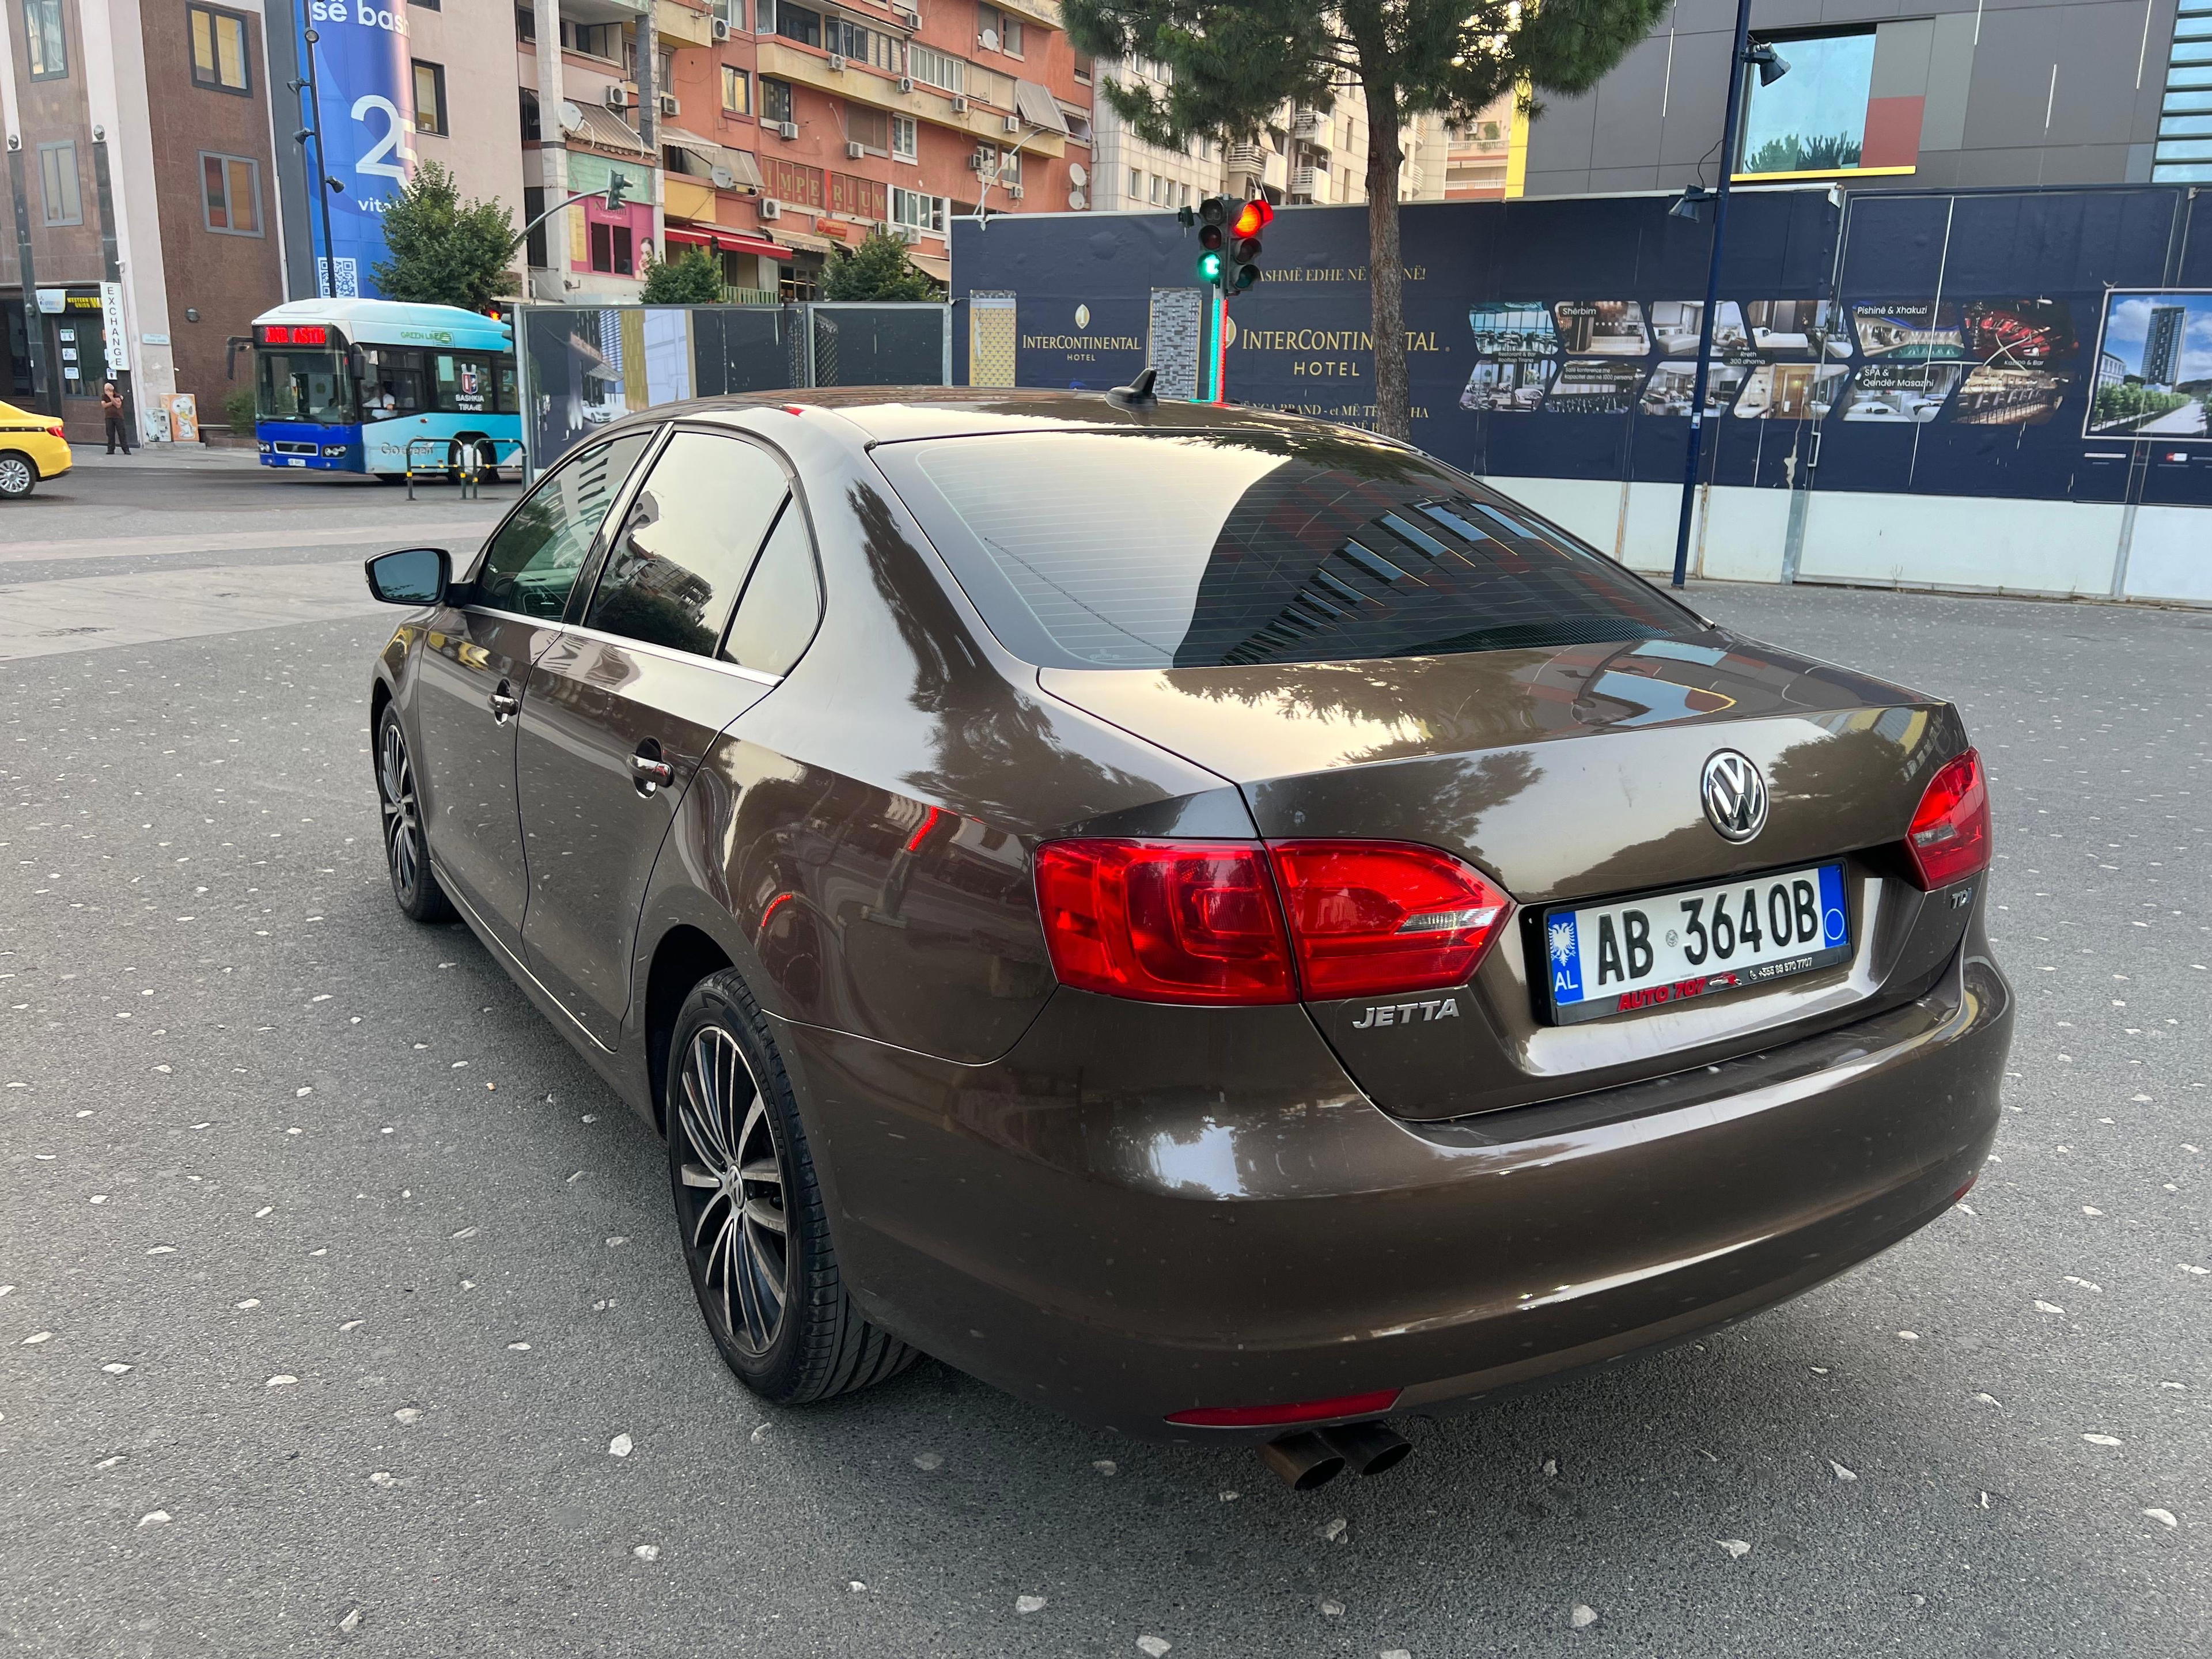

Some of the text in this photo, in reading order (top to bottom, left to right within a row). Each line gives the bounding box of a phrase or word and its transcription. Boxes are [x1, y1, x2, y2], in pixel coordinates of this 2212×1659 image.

[1306, 269, 1344, 281] EDHE
[1347, 266, 1366, 281] NË
[1857, 305, 1928, 315] Pishinë & Xhakuzi
[107, 287, 123, 366] EXCHANGE
[1023, 335, 1141, 350] INTERCONTINENTAL
[1243, 329, 1440, 351] INTERCONTINTAL
[1293, 362, 1360, 376] HOTEL
[1864, 369, 1889, 377] SPA &
[1342, 403, 1361, 416] MË
[1597, 908, 1654, 985] AB
[1554, 971, 1579, 993] AL
[1617, 976, 1707, 1012] AUTO 707
[1352, 998, 1460, 1029] JETTA
